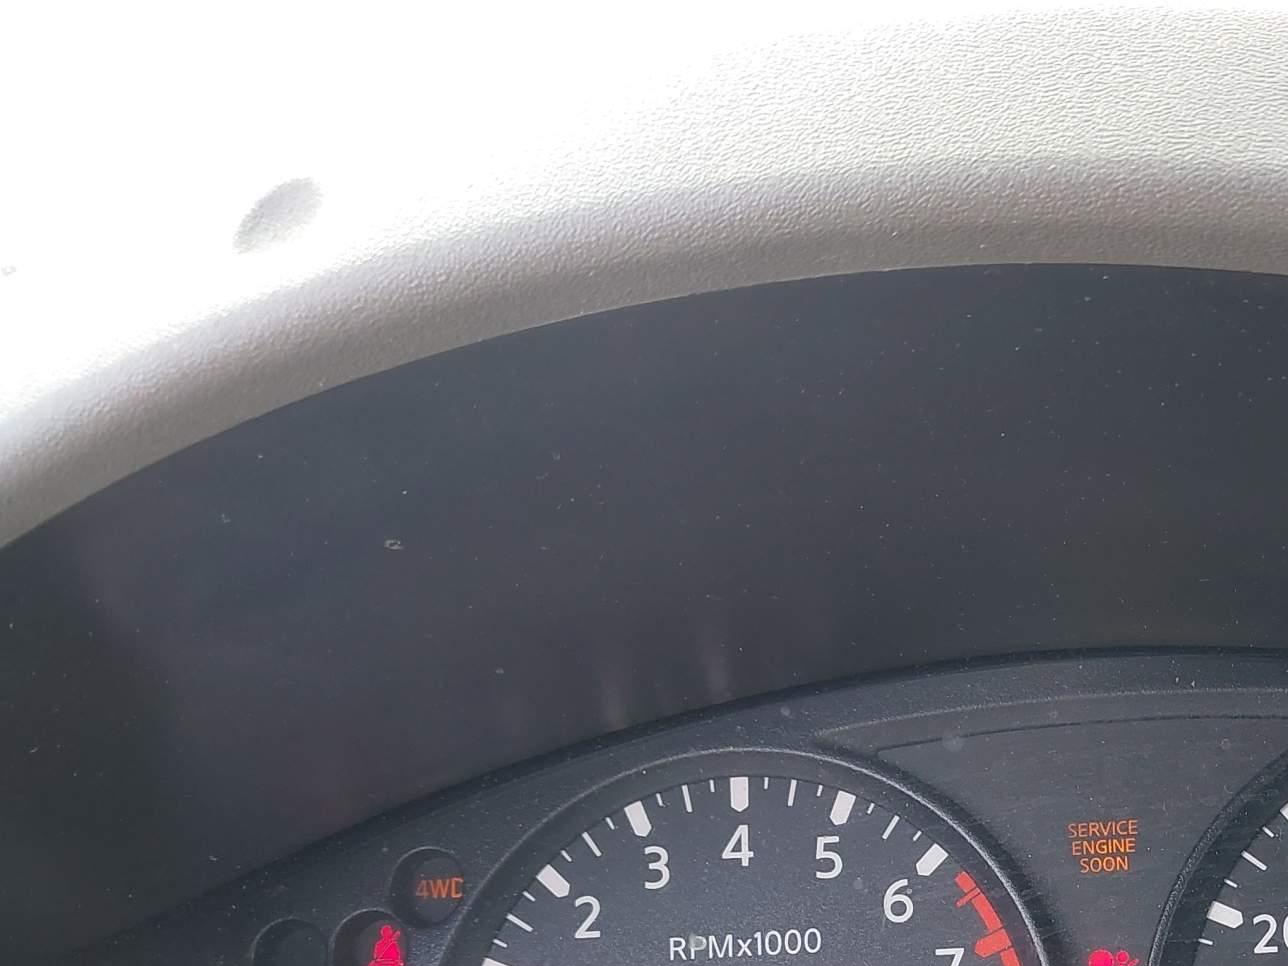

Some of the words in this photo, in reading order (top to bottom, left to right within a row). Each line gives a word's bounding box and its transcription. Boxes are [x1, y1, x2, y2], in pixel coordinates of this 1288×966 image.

[722, 825, 753, 866] 4
[1068, 820, 1138, 838] SERVICE
[1072, 838, 1136, 855] ENGINE
[644, 846, 670, 889] 3
[815, 836, 843, 878] 5
[1080, 855, 1129, 873] SOON
[575, 897, 600, 938] 2
[884, 879, 914, 923] 6
[669, 929, 822, 960] RPMx1000
